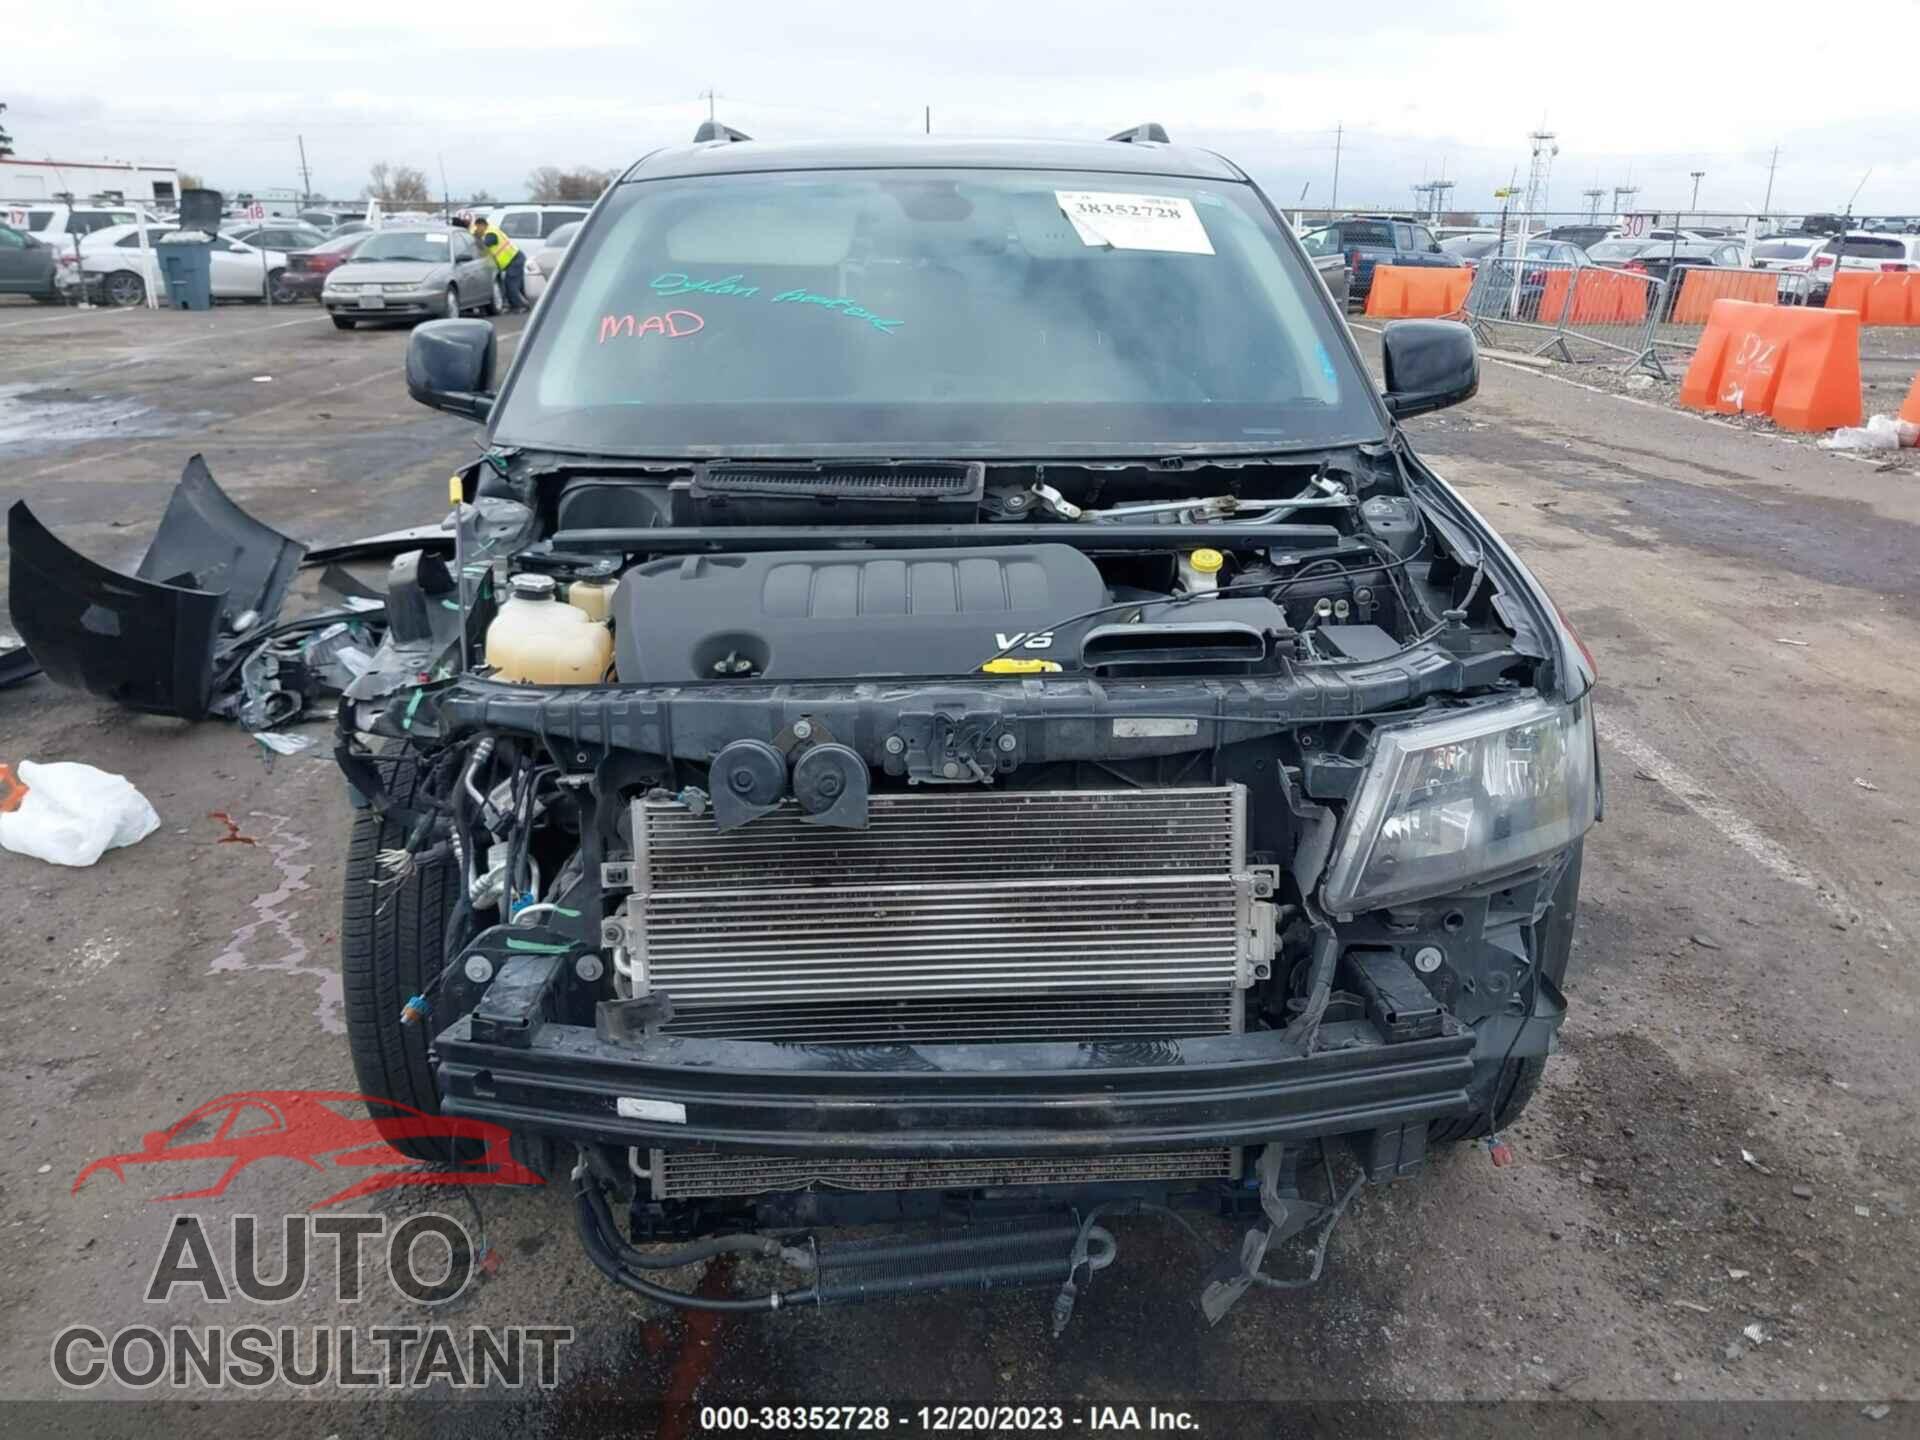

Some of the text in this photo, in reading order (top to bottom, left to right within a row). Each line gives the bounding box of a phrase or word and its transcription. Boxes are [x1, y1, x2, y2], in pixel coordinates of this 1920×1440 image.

[1075, 203, 1181, 219] 38352728
[1621, 214, 1644, 237] 30
[599, 310, 704, 343] MAD
[995, 631, 1054, 649] V6
